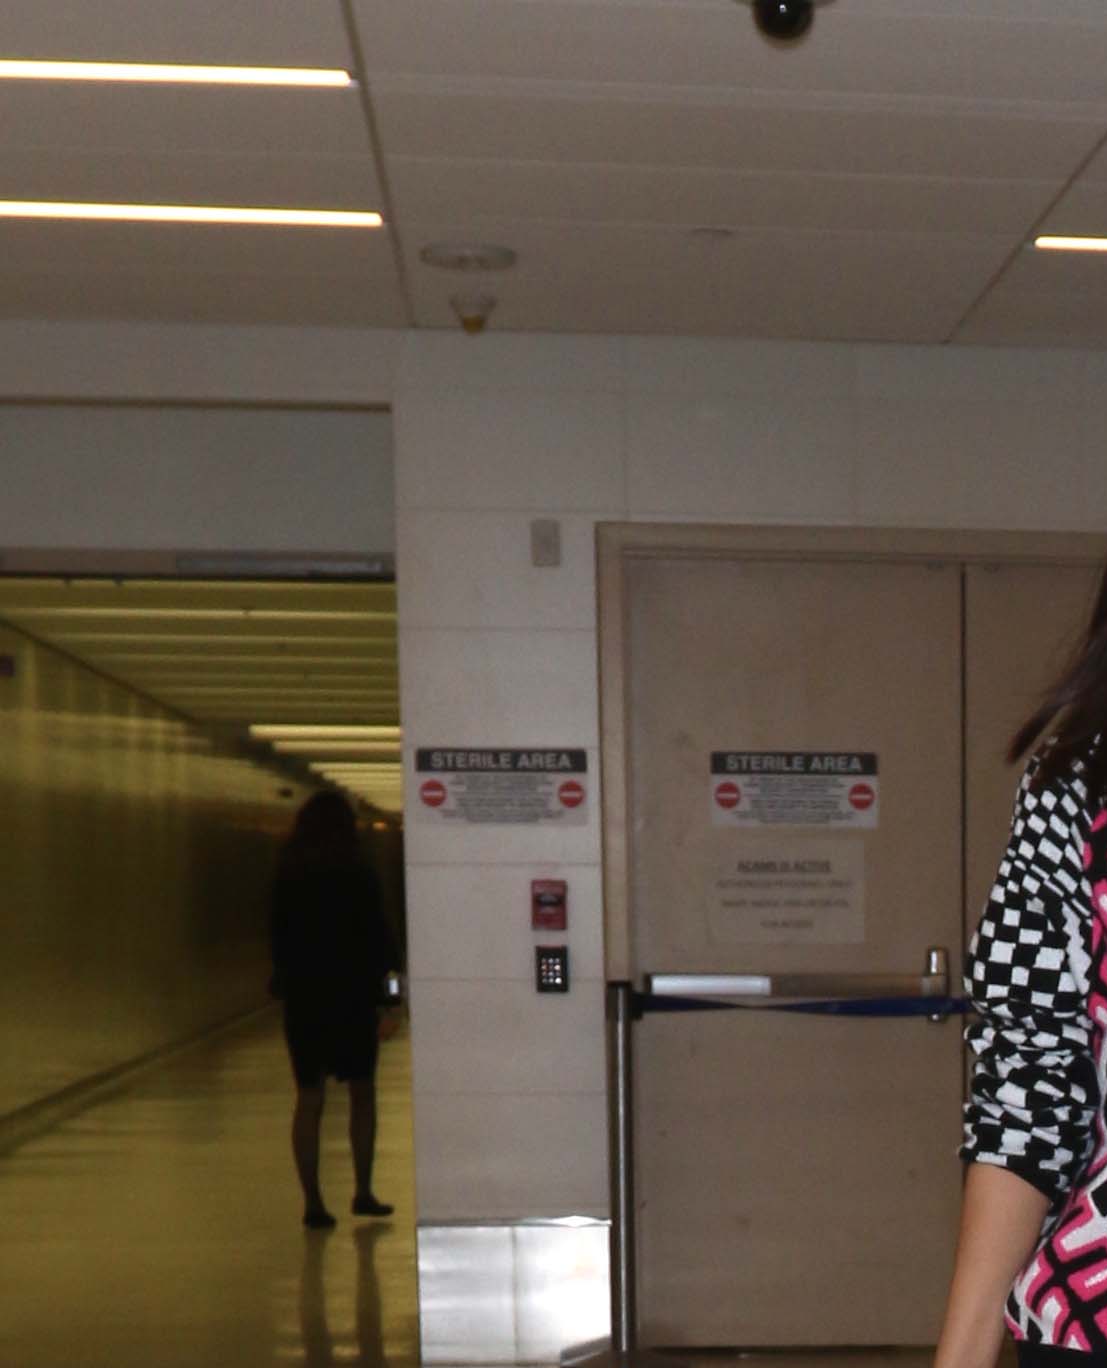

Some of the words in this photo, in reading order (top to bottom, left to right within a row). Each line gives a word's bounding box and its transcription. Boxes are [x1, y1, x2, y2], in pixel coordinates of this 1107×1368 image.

[431, 751, 512, 768] STERILE
[516, 752, 572, 769] AREA
[727, 755, 804, 771] STERILE
[809, 756, 862, 772] AREA
